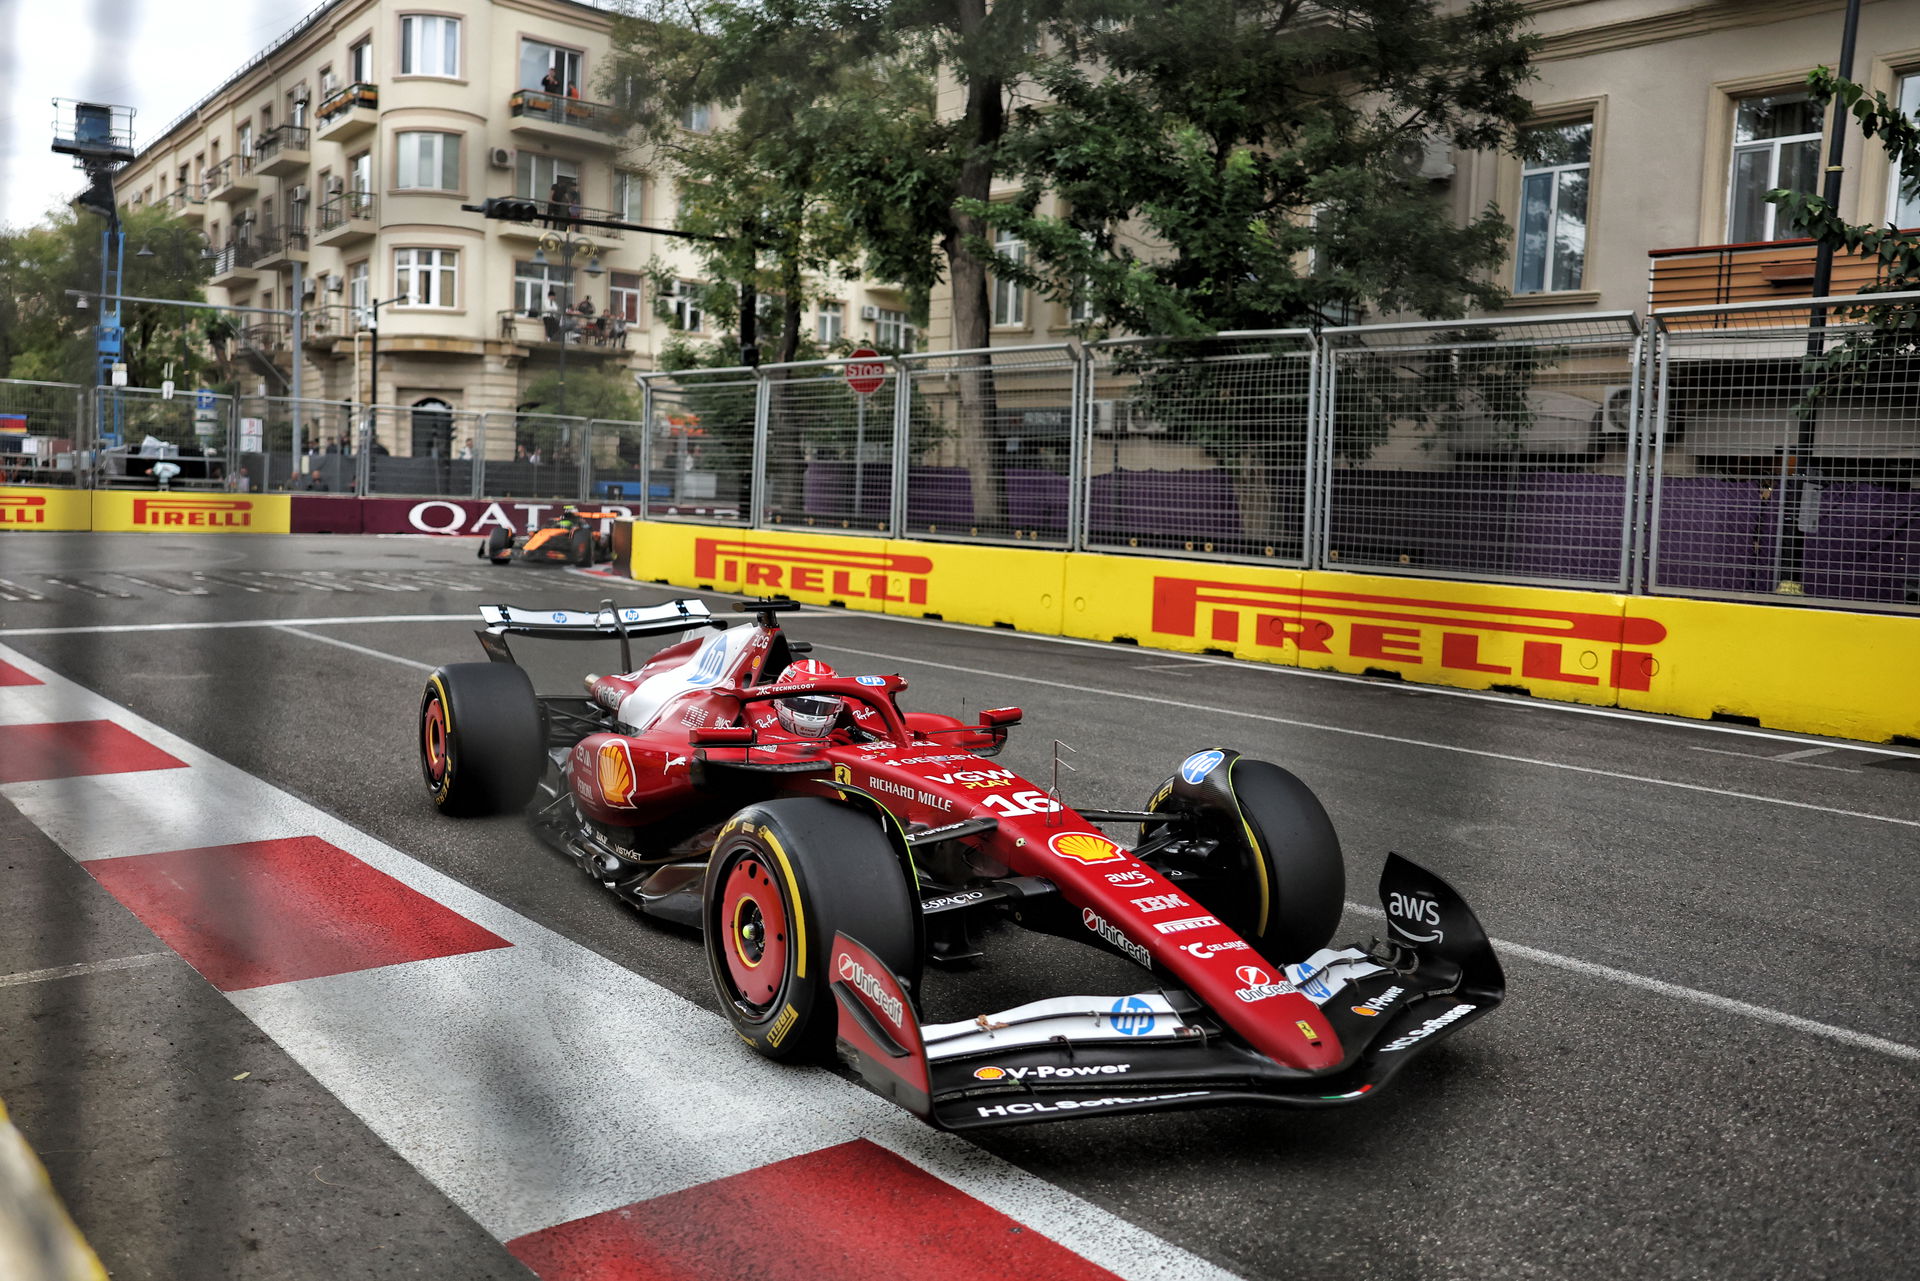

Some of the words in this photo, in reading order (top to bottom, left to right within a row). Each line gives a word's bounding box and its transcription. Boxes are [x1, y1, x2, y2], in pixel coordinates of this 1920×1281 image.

[848, 364, 882, 377] STOP
[133, 499, 253, 526] PIRELLI
[695, 538, 933, 605] PIRELLI
[553, 612, 567, 624] hp
[625, 609, 639, 621] hp
[752, 634, 769, 649] ZCG
[1152, 576, 1667, 692] PIRELLI
[772, 683, 815, 692] TECHNOLOGY
[857, 676, 885, 686] hp
[924, 768, 1016, 785] VGW
[1184, 751, 1221, 784] hp
[869, 776, 915, 800] RICHARD
[917, 790, 953, 813] MILLE
[961, 778, 1012, 790] PLAY
[982, 790, 1065, 817] 16
[1104, 870, 1146, 884] aws
[1130, 894, 1189, 912] IBM
[1389, 892, 1441, 926] aws
[1152, 916, 1221, 934] PIRELLI
[1096, 916, 1152, 970] UniCredit
[1206, 941, 1247, 952] CELSIUS
[853, 961, 903, 1029] UniCredit
[1235, 980, 1298, 1002] UniCredit
[1362, 985, 1405, 1011] V-Power
[766, 1003, 799, 1048] PIRELLI
[1112, 997, 1154, 1035] hp
[1379, 1004, 1477, 1052] HCLSoftware
[1006, 1064, 1130, 1080] V-Power
